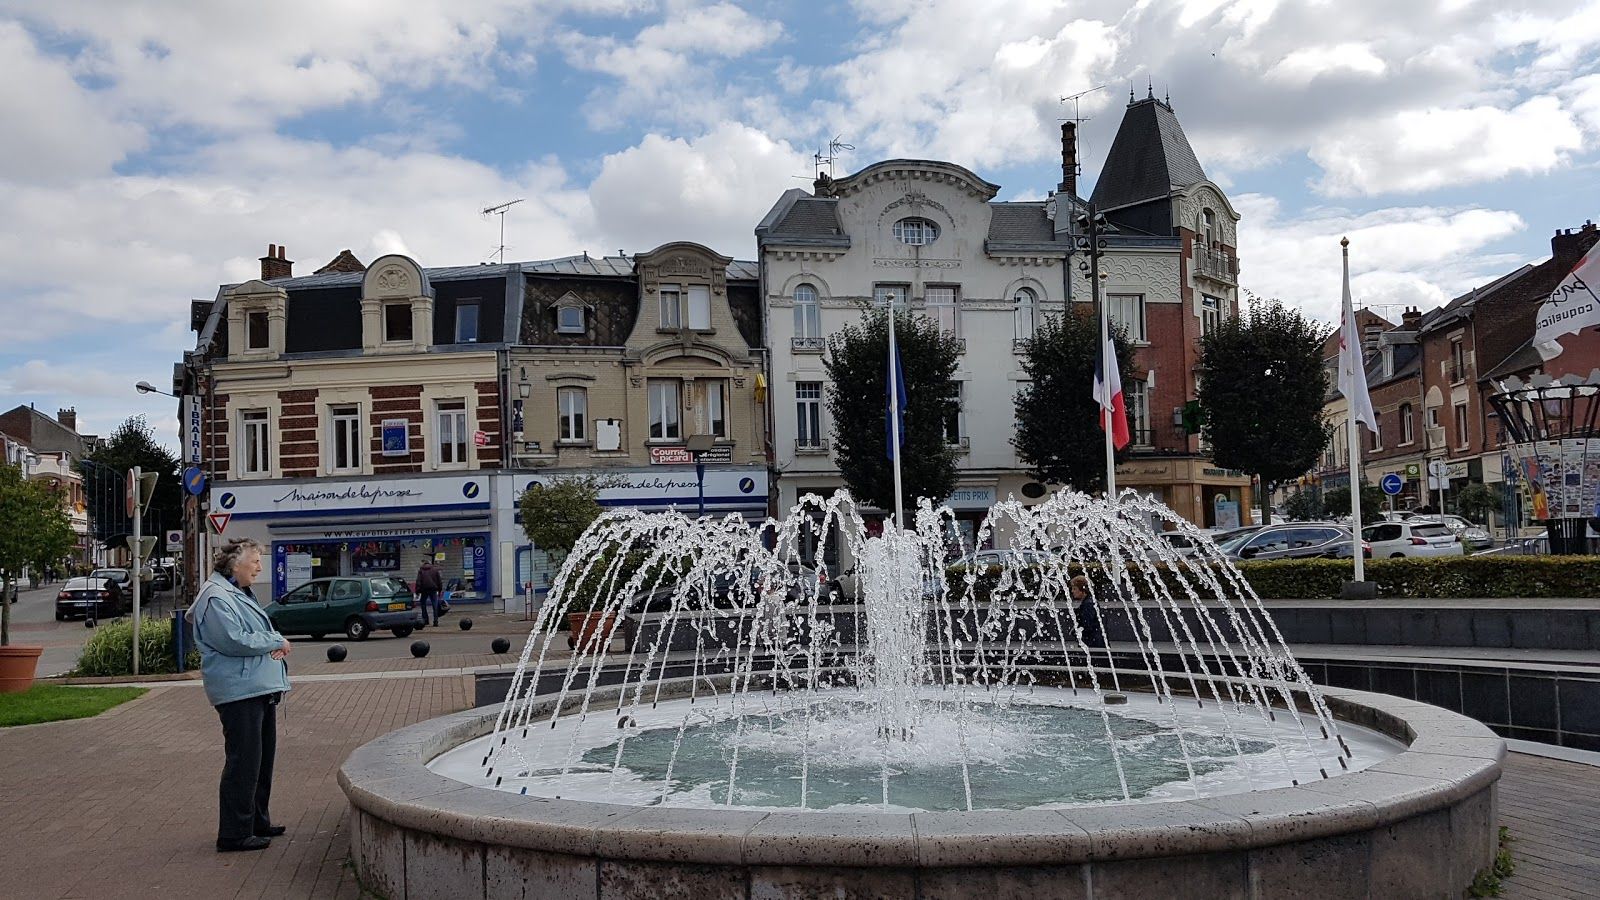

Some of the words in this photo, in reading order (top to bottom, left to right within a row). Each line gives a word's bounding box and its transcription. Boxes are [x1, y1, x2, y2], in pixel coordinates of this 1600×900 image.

[191, 396, 200, 463] LIBRAIRIE
[660, 454, 689, 464] picard
[972, 490, 989, 500] PRIX
